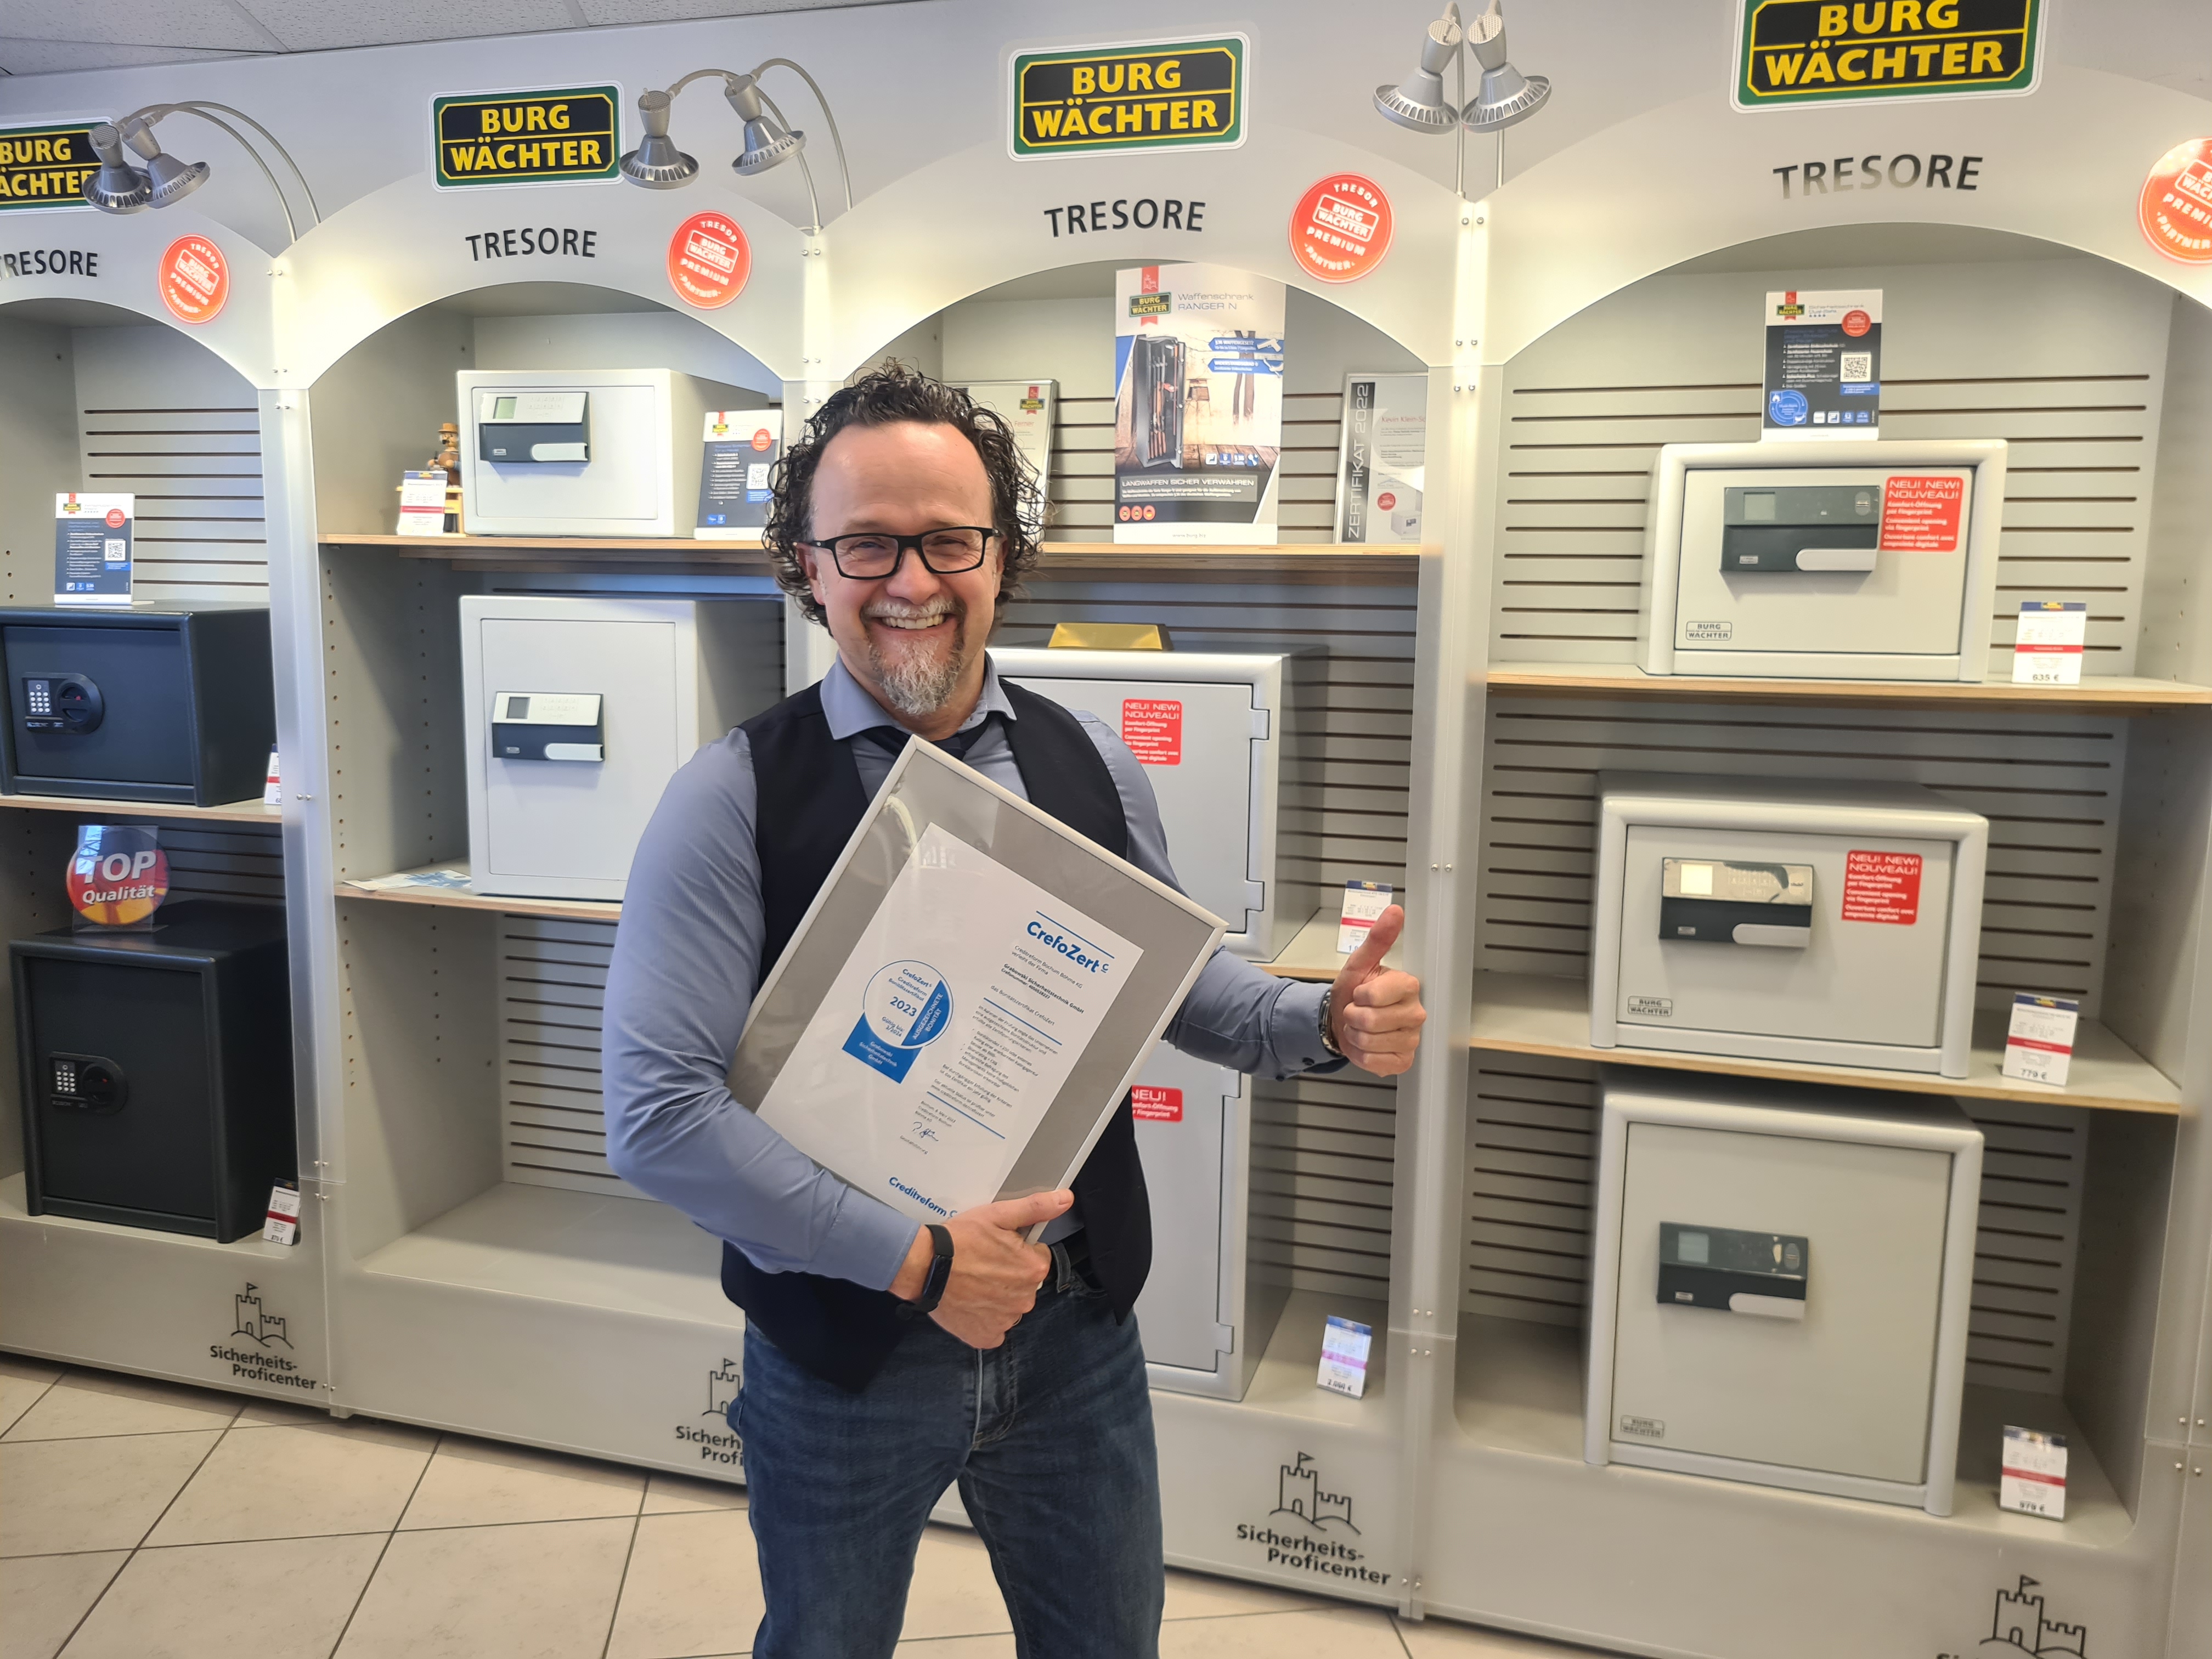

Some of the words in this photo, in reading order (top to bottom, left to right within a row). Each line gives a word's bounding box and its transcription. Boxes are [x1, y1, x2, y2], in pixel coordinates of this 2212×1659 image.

[1818, 0, 1959, 37] BURG
[1764, 40, 2004, 86] WÄCHTER
[1073, 60, 1182, 95] BURG
[481, 105, 570, 134] BURG
[1032, 97, 1218, 138] WÄCHTER
[0, 138, 71, 164] BURG
[450, 136, 602, 172] WÄCHTER
[0, 166, 95, 197] ÄCHTE
[1773, 154, 1983, 199] TRESORE
[1334, 183, 1378, 207] TRESOR
[1043, 199, 1206, 238] TRESORE
[1333, 203, 1364, 222] BURG
[465, 228, 597, 261] TRESORE
[700, 221, 737, 242] TRESOR
[1306, 227, 1365, 256] PREMIUM
[191, 244, 219, 269] TRESOR
[701, 238, 726, 255] BURG
[1306, 246, 1351, 270] PARTNER
[0, 250, 98, 279] RESORE
[680, 258, 729, 285] PREMIUM
[171, 273, 209, 305] PREMIUM
[680, 275, 718, 297] PARTNER
[1139, 296, 1160, 304] BURG
[1355, 384, 1369, 433] 2022
[1348, 439, 1364, 538] ZERTIFIKAT
[1888, 489, 1959, 499] NOUVEAU!
[1889, 480, 1920, 489] NEU!
[1926, 480, 1960, 489] NEW!
[1125, 711, 1179, 720] NOUVEAU!
[84, 851, 156, 884] TOP
[1849, 863, 1918, 875] NOUVEAU!
[1850, 854, 1881, 864] NEU!
[1885, 856, 1918, 866] NEW!
[83, 885, 155, 905] Qualität
[1015, 946, 1042, 963] Creditreform
[1042, 962, 1059, 974] Bochum
[1027, 922, 1099, 972] CrefoZert
[898, 977, 927, 996] Creditreform
[902, 969, 928, 986] CrefoZert
[1004, 964, 1028, 979] Grabowski
[1028, 978, 1068, 1005] Sicherheitstechnik
[1069, 1003, 1084, 1013] GmbH
[890, 996, 916, 1016] 2023
[912, 993, 943, 1039] AUSGEZEICHNETE
[1035, 1011, 1054, 1025] CrefoZert
[882, 1017, 895, 1028] Gültig
[924, 1008, 941, 1031] BONITÄT
[889, 1176, 947, 1217] Creditreform
[210, 1345, 297, 1371] Sicherheits-
[233, 1364, 317, 1389] Proficenter
[676, 1425, 741, 1449] Sicherh
[702, 1446, 743, 1466] Profi
[1237, 1524, 1364, 1560] Sicherheits-
[1267, 1548, 1391, 1584] Proficenter
